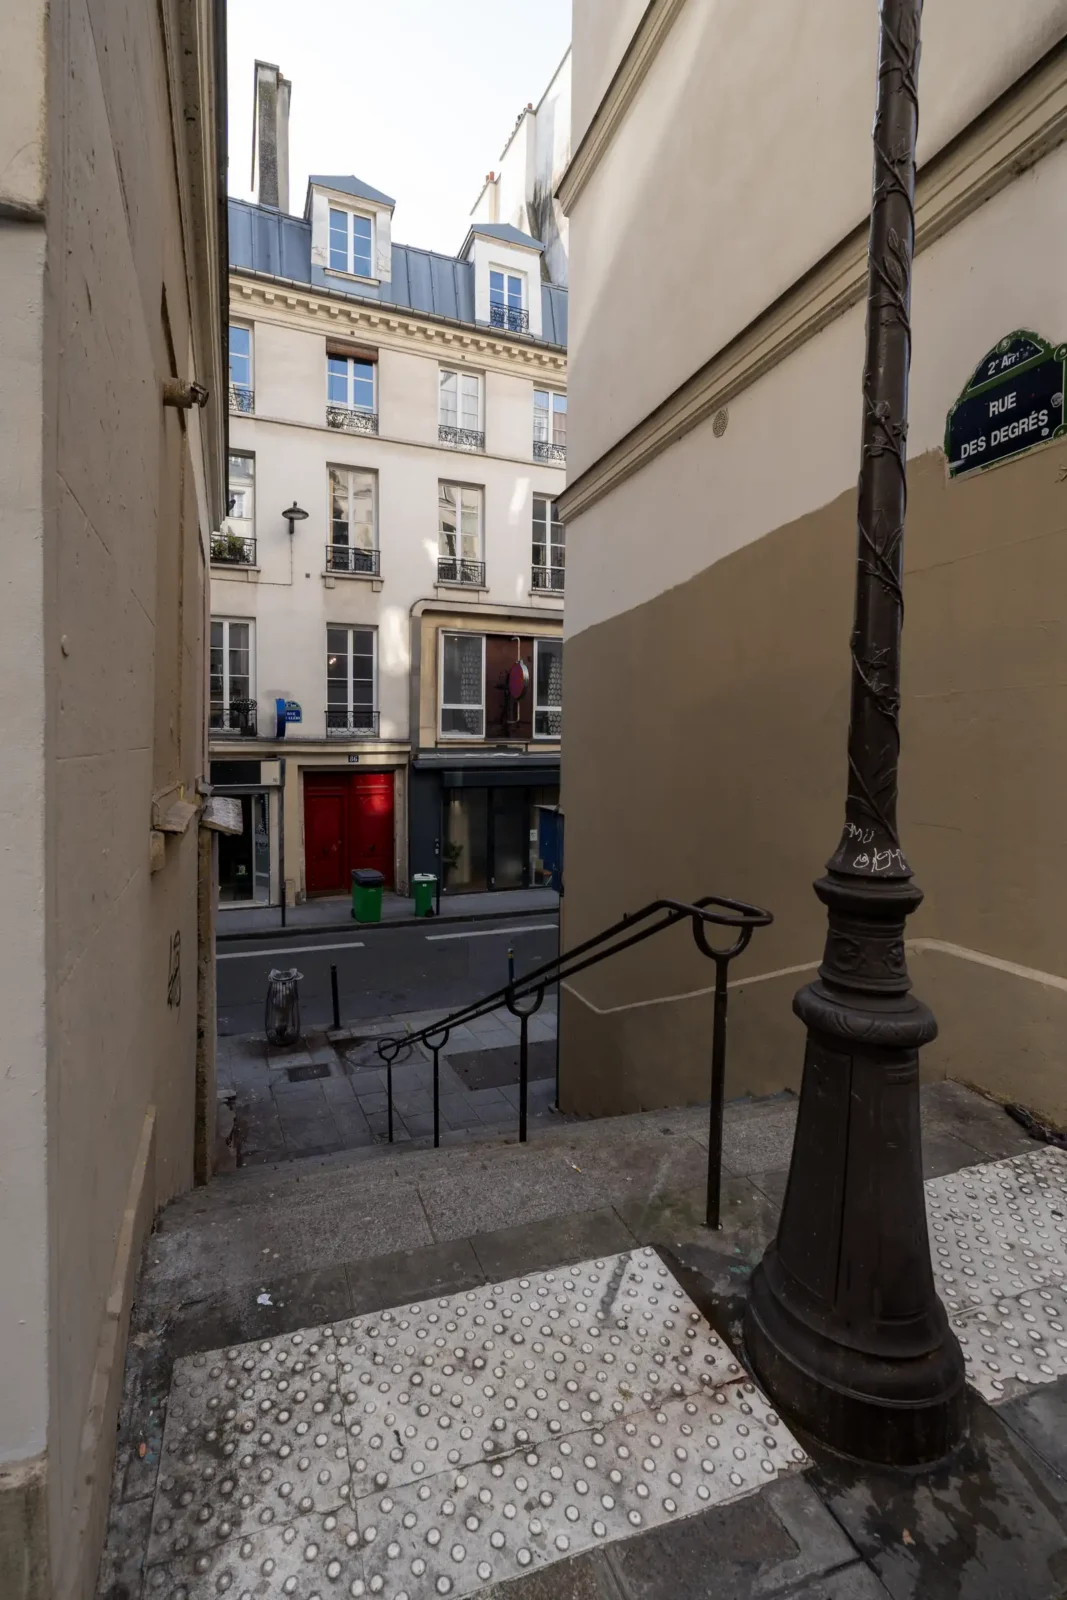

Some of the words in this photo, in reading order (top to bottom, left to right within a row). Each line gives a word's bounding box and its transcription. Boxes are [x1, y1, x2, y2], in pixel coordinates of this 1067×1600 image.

[989, 391, 1017, 418] RUE
[960, 435, 986, 459] DES
[991, 409, 1049, 447] DEGRÉS
